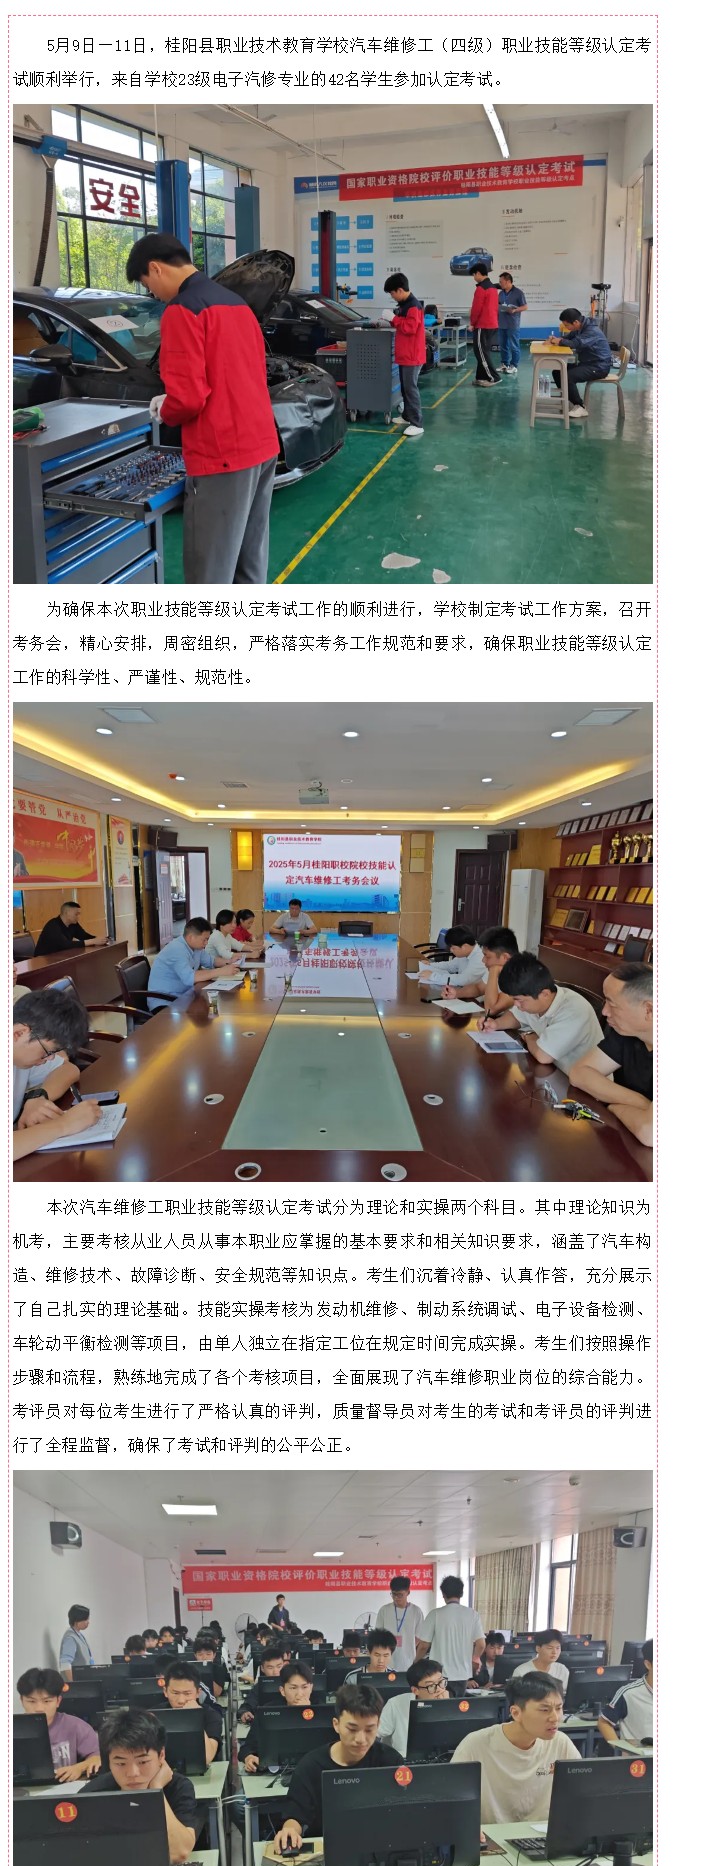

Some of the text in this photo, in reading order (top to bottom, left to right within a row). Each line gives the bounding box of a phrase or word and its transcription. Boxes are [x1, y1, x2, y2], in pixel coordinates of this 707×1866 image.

[13, 71, 500, 87] 试顺利举行，来自学校23级电子汽修专业的42名学生参加认定考试。
[346, 161, 576, 189] 国家职业资格院校评价职业技能等级认定考试
[89, 178, 141, 218] 安全
[47, 601, 651, 617] 为确保本次职业技能等级认定考试工作的顺利进行，学校制定考试工作方案，召开
[13, 635, 651, 651] 考务会，精心安排，周密组织，严格落实考务工作规范和要求，确保职业技能等级认定
[13, 669, 250, 685] 工作的科学性、严谨性、规范性。
[268, 859, 396, 871] 2025年5月桂阳职校院校技能认
[285, 875, 379, 886] 定汽车维修工考务会议
[47, 1199, 649, 1215] 本次汽车维修工职业技能等级认定考试分为理论和实操两个科目。其中理论知识为
[13, 1233, 650, 1249] 机考，主要考核从业人员从事本职业应掌握的基本要求和相关知识要求，涵盖了汽车构
[13, 1267, 651, 1283] 造、维修技术、故障诊断、安全规范等知识点。考生们沉着冷静、认真作答，充分展示
[13, 1301, 642, 1317] 了自己扎实的理论基础。技能实操考核为发动机维修、制动系统调试、电子设备检测、
[13, 1335, 651, 1351] 车轮动平衡检测等项目，由单人独立在指定工位在规定时间完成实操。考生们按照操作
[13, 1369, 642, 1385] 步骤和流程，熟练地完成了各个考核项目，全面展现了汽车维修职业岗位的综合能力。
[13, 1403, 651, 1419] 考评员对每位考生进行了严格认真的评判，质量督导员对考生的考试和考评员的评判进
[13, 1437, 350, 1453] 行了全程监督，确保了考试和评判的公平公正。
[192, 1568, 432, 1582] 国家职业资格院校评价职业技能等级认定考试
[396, 1771, 411, 1781] 21
[631, 1764, 644, 1774] 31
[57, 1806, 77, 1819] 11
